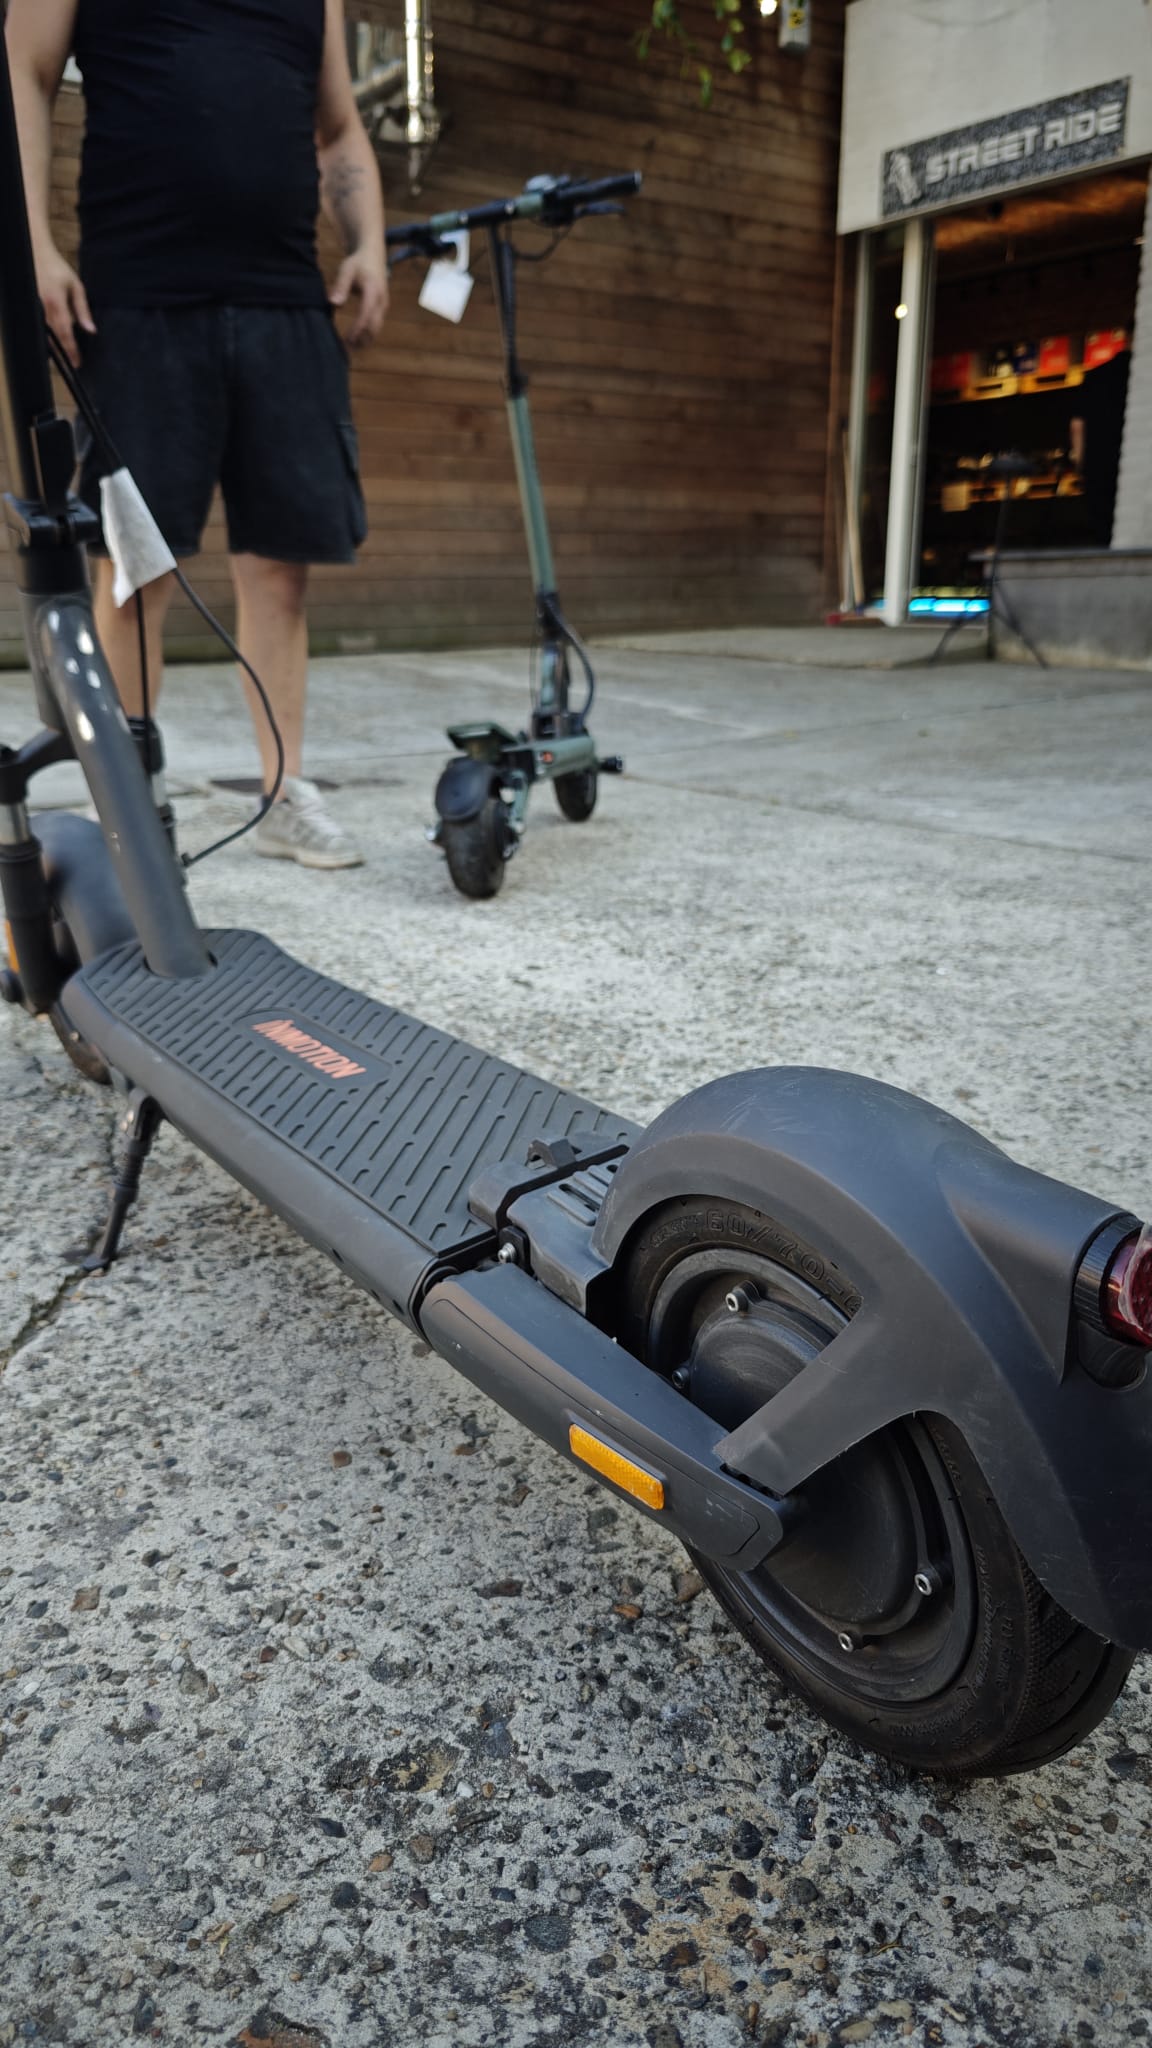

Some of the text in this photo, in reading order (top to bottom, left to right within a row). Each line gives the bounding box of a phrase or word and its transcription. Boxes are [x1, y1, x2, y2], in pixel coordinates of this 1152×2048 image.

[925, 101, 1123, 185] STREET RIDE
[251, 1019, 367, 1079] INMOTION
